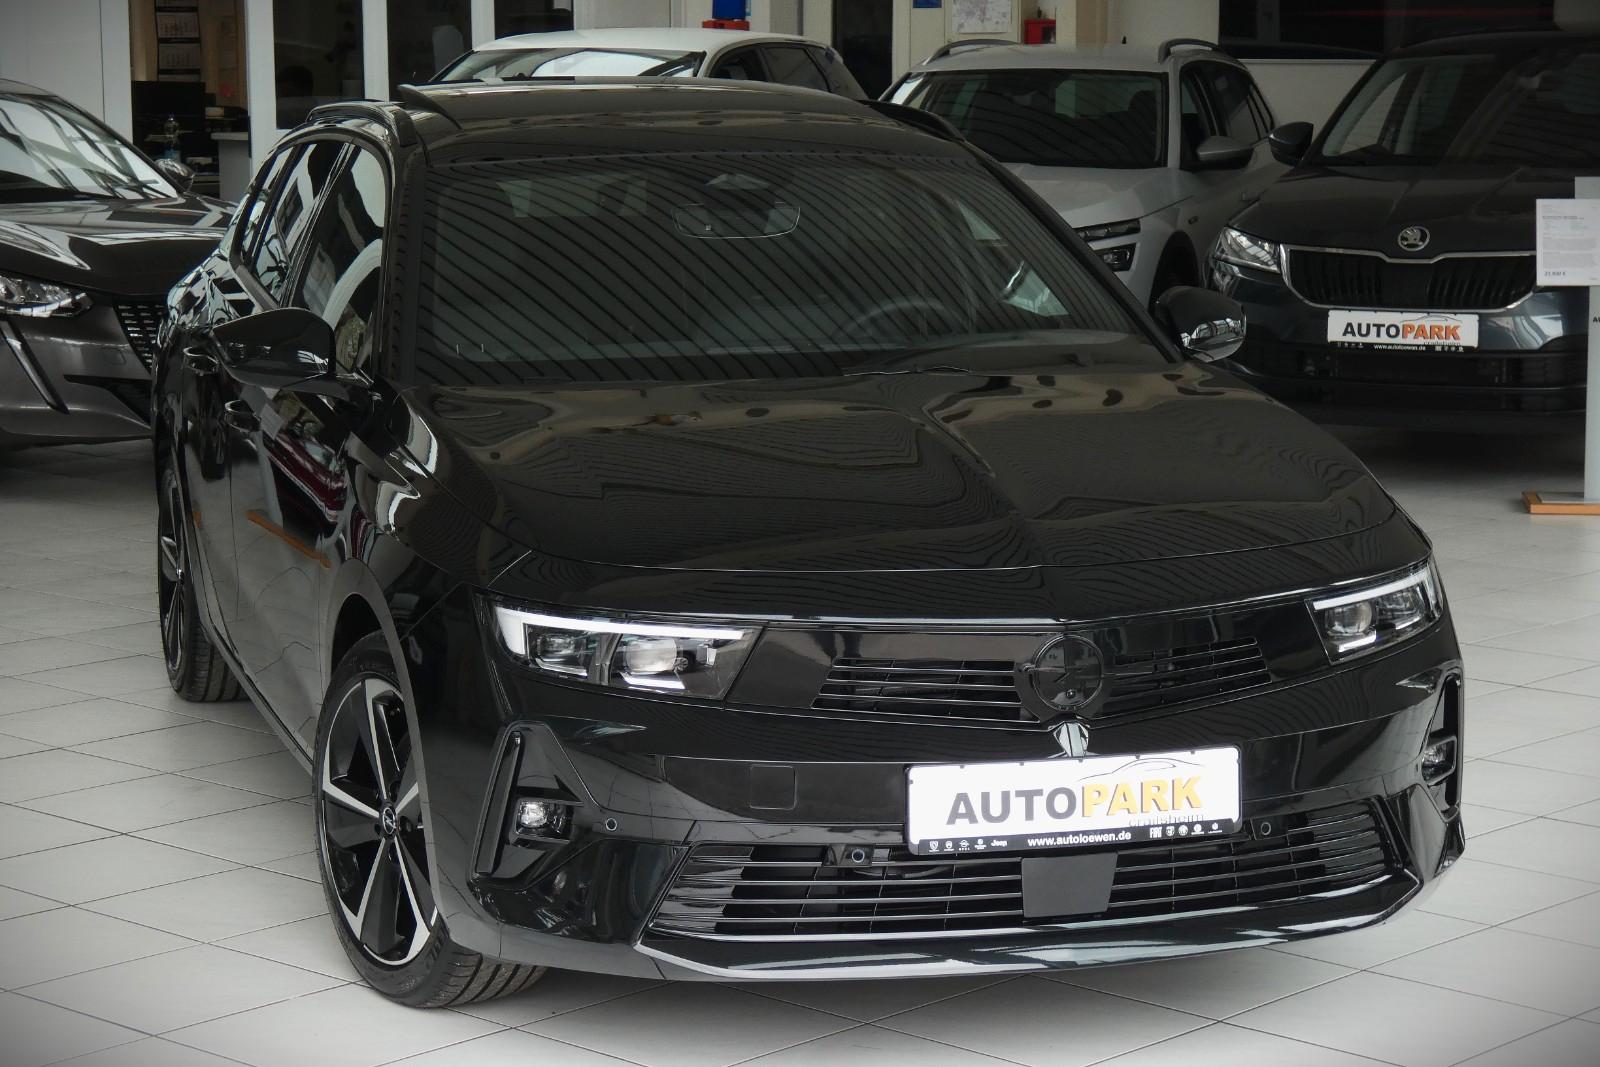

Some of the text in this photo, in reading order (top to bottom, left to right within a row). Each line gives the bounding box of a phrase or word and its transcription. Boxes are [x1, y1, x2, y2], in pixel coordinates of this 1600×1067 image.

[1343, 322, 1461, 340] AUTOPARK
[946, 775, 1202, 825] AUTOPARK
[991, 839, 1008, 847] Jeep
[1027, 831, 1131, 847] www.autoloewen.de
